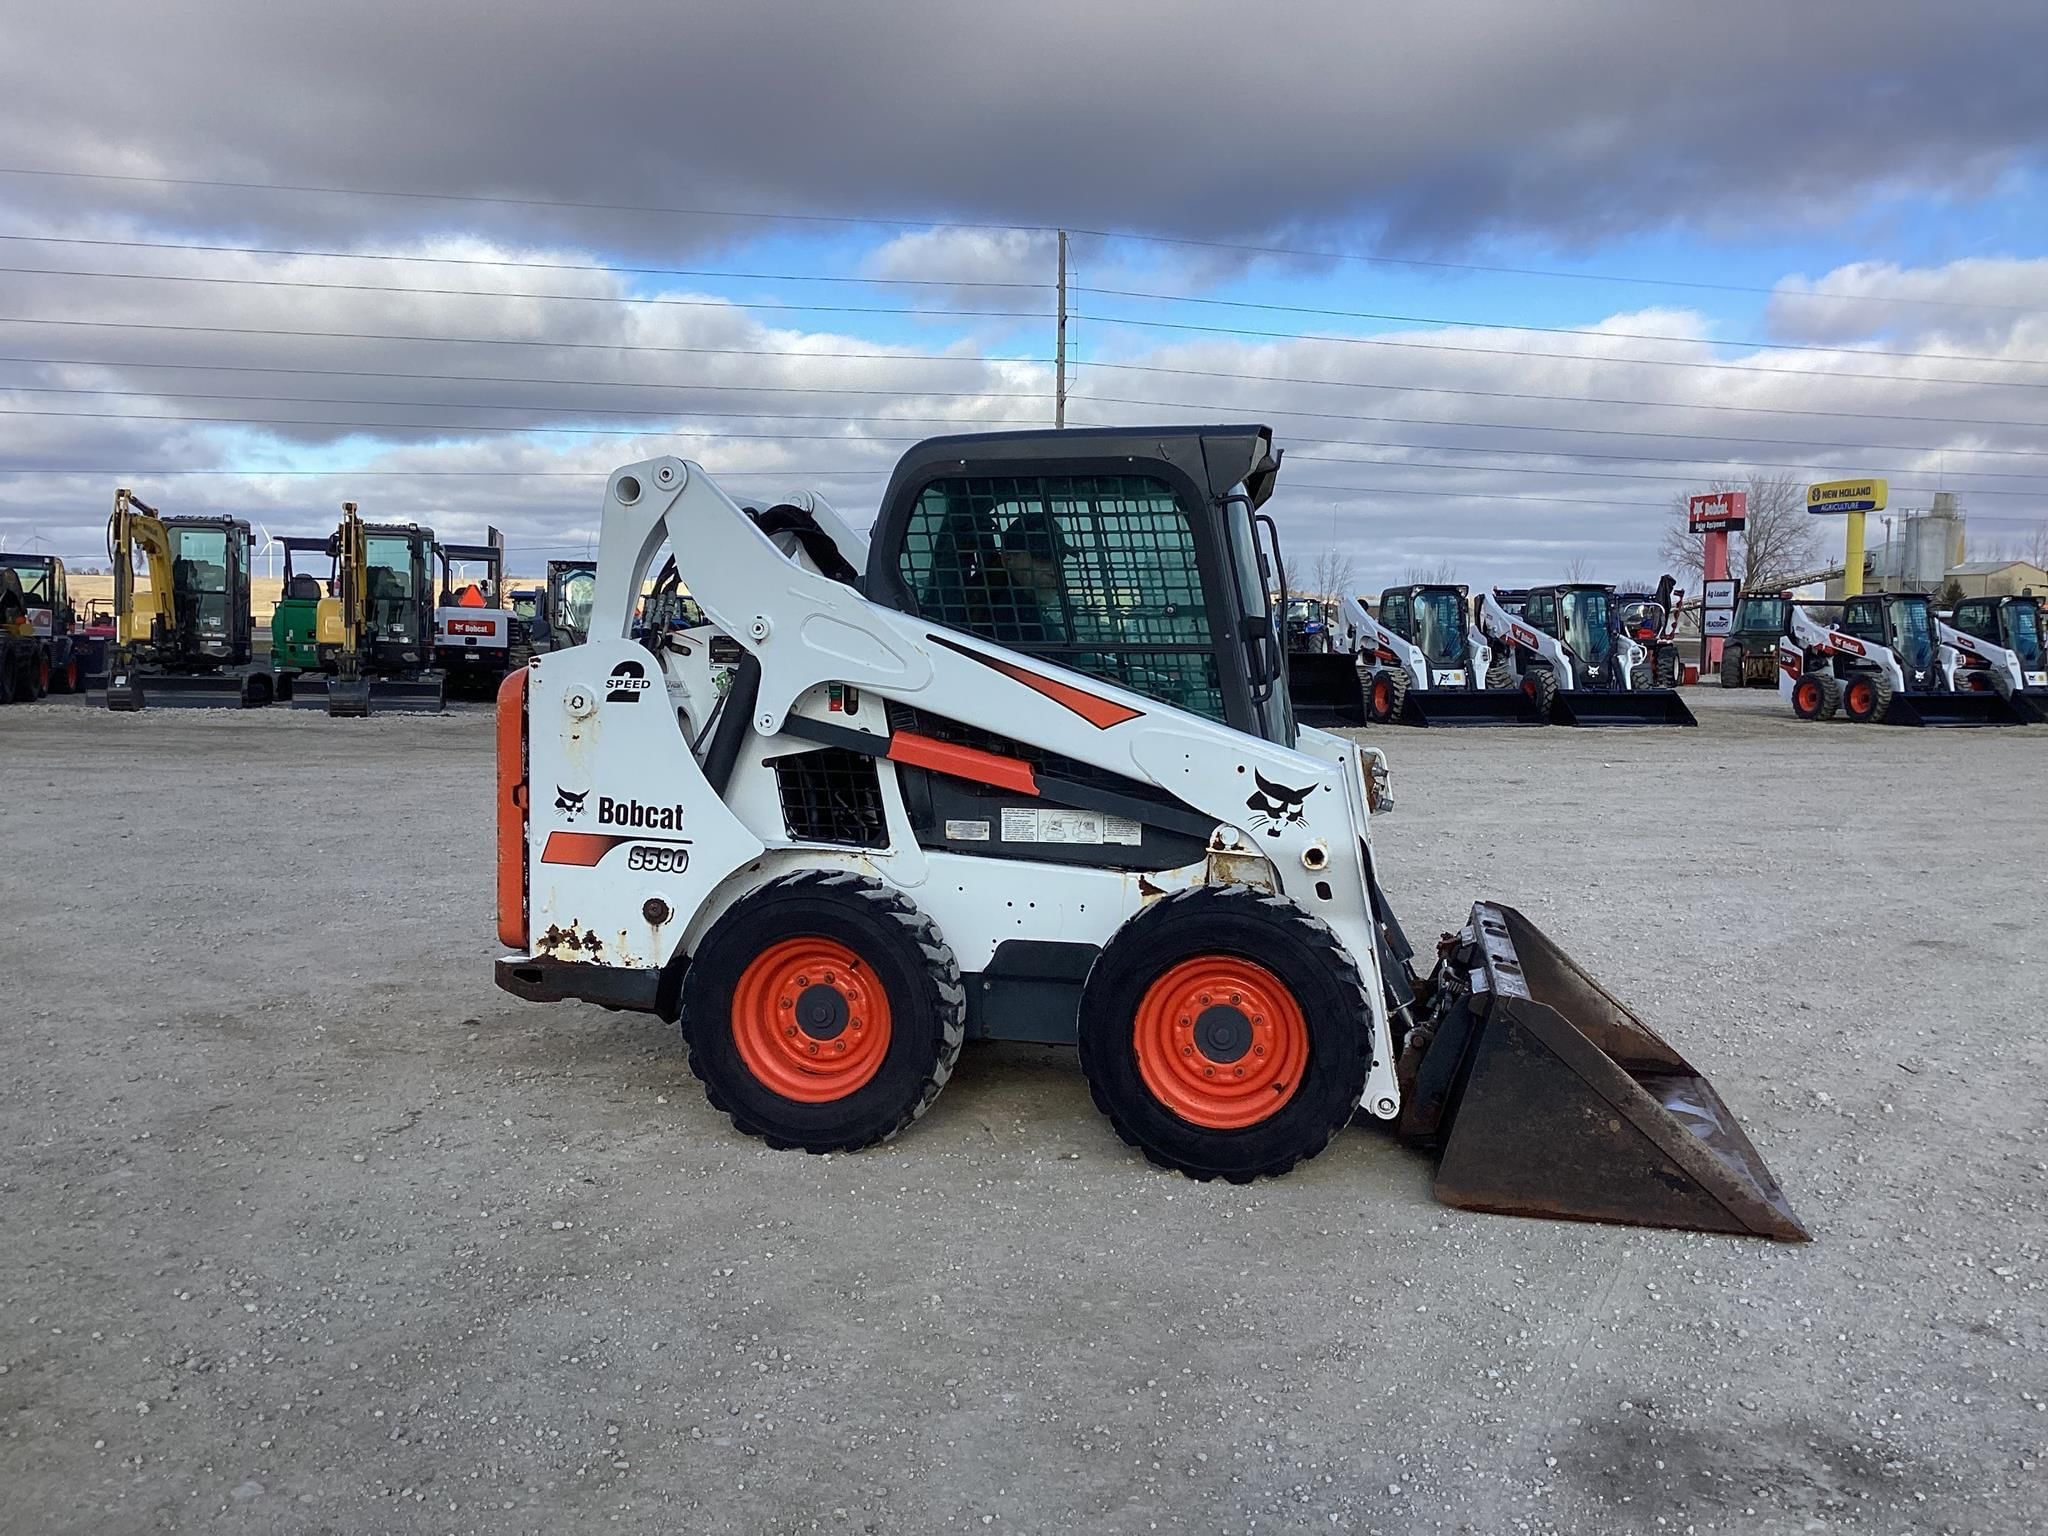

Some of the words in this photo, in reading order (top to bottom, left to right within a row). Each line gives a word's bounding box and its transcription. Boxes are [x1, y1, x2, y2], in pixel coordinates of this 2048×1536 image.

[1822, 489, 1838, 499] NEW
[1840, 486, 1871, 498] HOLLAND
[1705, 501, 1729, 516] Bobcat
[1821, 501, 1859, 512] AGRICULTURE
[465, 624, 489, 633] Bobcat
[605, 679, 651, 689] SPEED
[598, 796, 684, 831] Bobcat
[628, 845, 690, 874] S590
